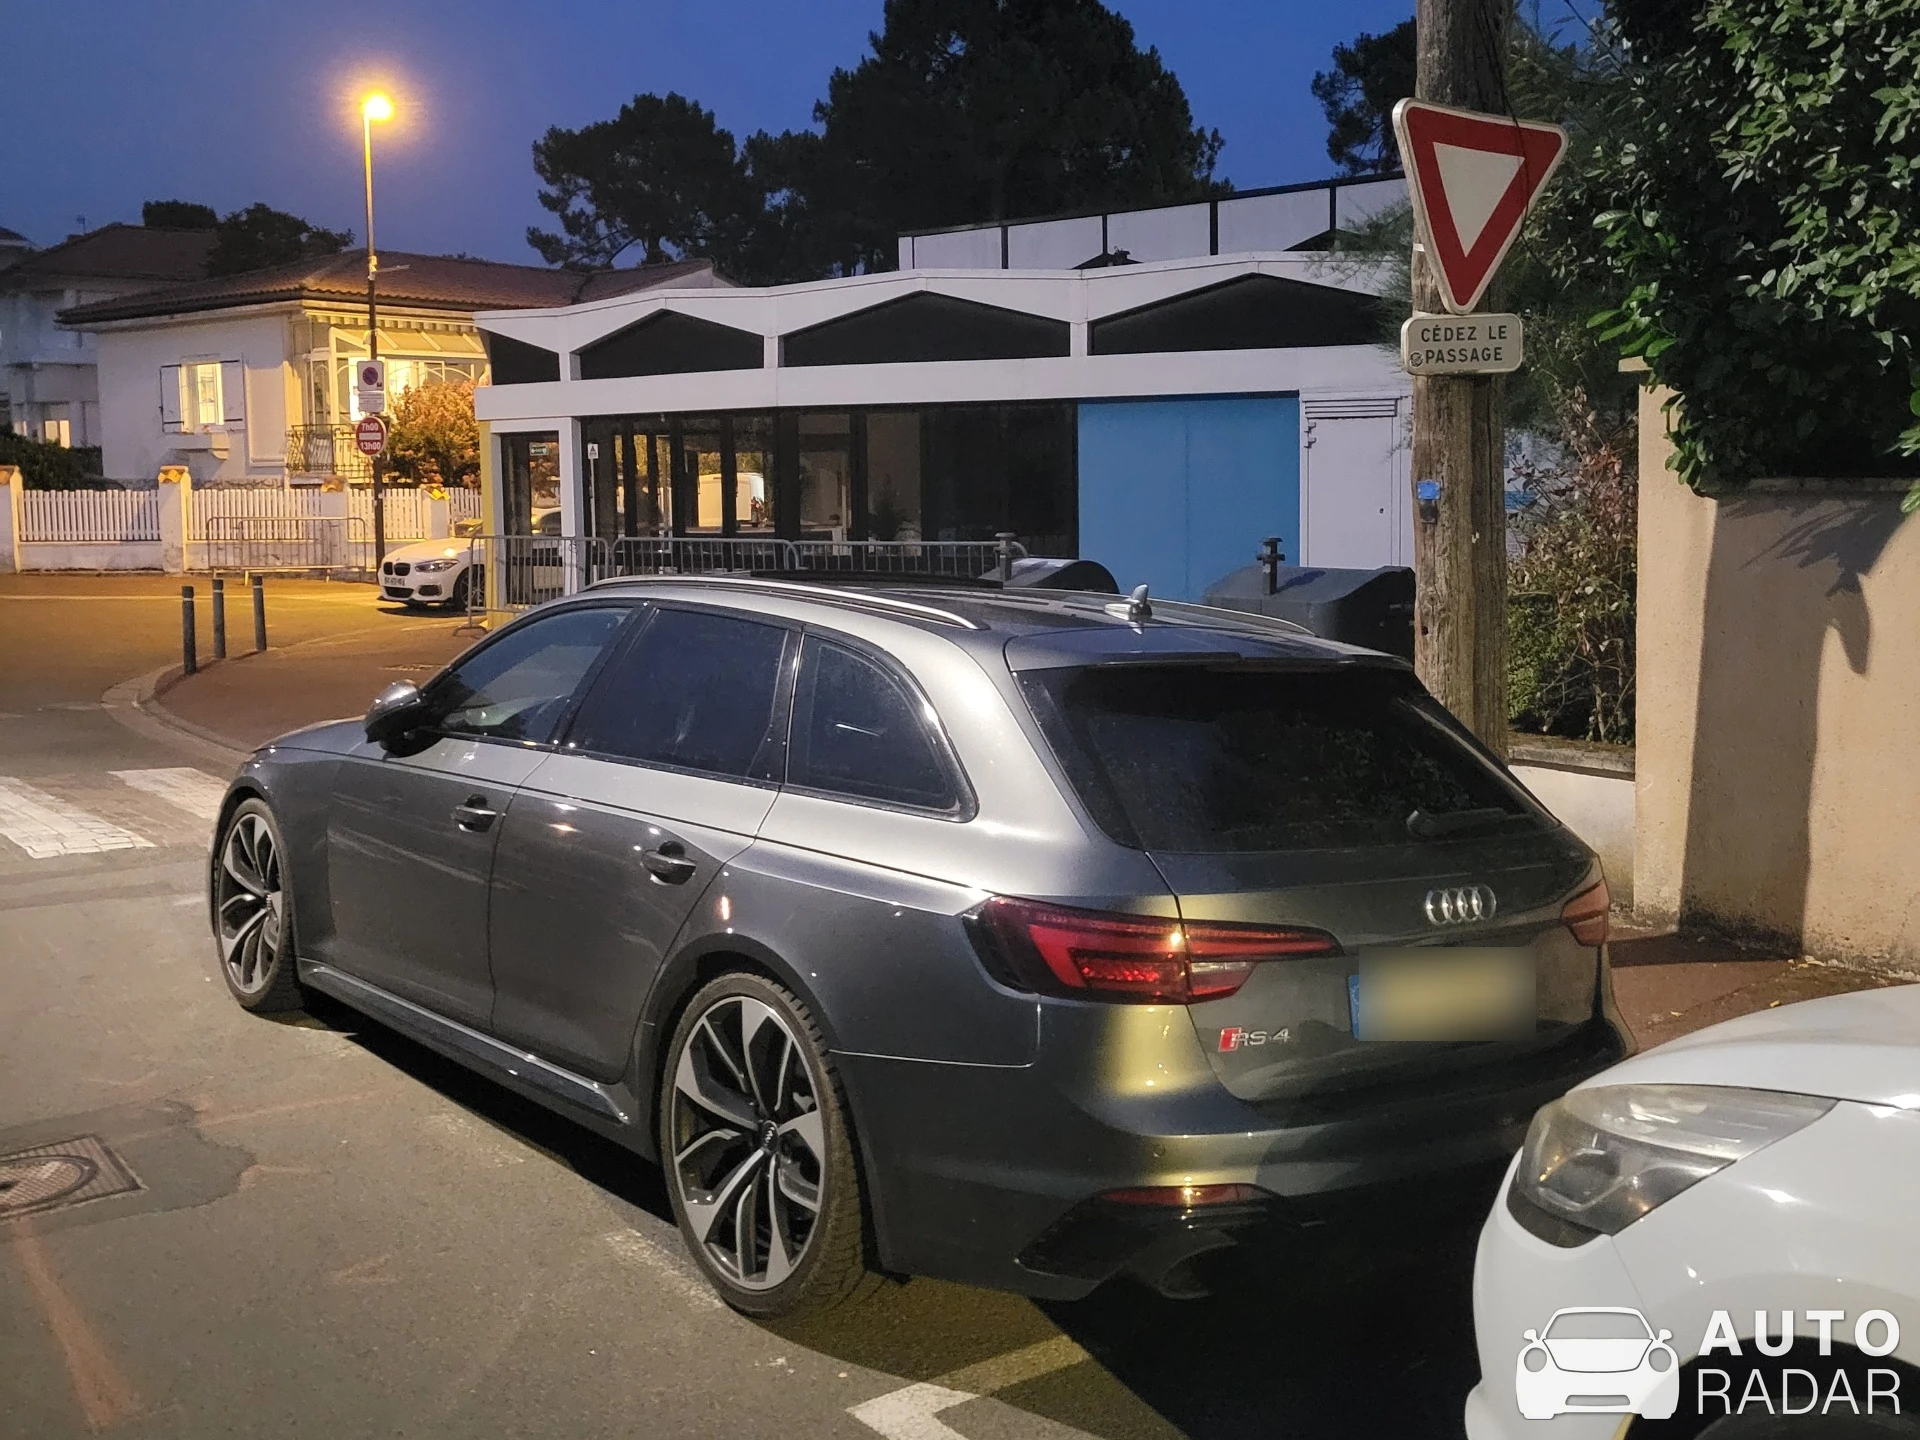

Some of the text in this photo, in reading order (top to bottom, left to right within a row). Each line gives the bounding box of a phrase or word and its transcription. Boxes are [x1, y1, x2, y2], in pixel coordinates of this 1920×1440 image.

[1421, 325, 1508, 342] CÉDEZ LE
[1425, 347, 1503, 363] PASSAGE
[361, 422, 379, 431] 7h00
[360, 441, 381, 450] 13h00
